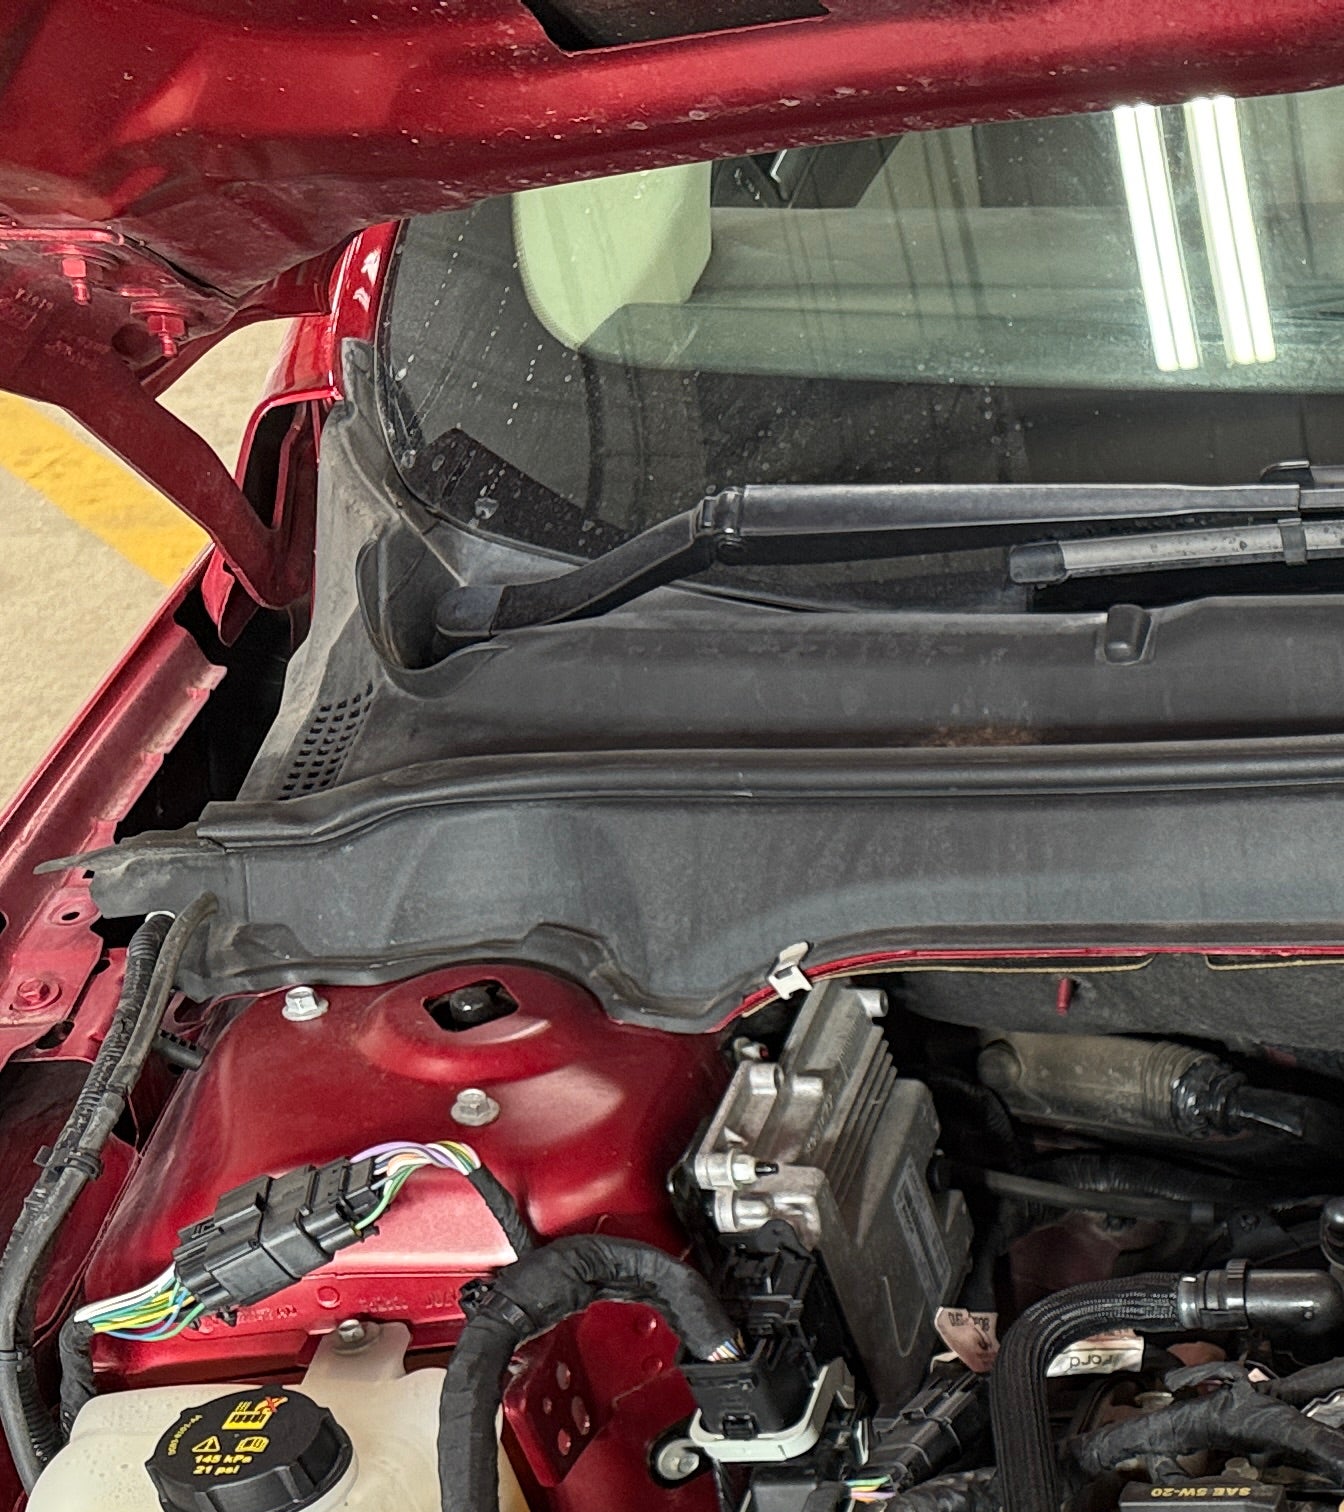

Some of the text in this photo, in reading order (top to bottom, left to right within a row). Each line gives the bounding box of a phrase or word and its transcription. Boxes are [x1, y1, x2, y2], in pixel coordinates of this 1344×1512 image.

[194, 1454, 252, 1464] 145 kPa
[193, 1465, 240, 1476] 21 psi
[1151, 1487, 1251, 1497] SAE 5W-20
